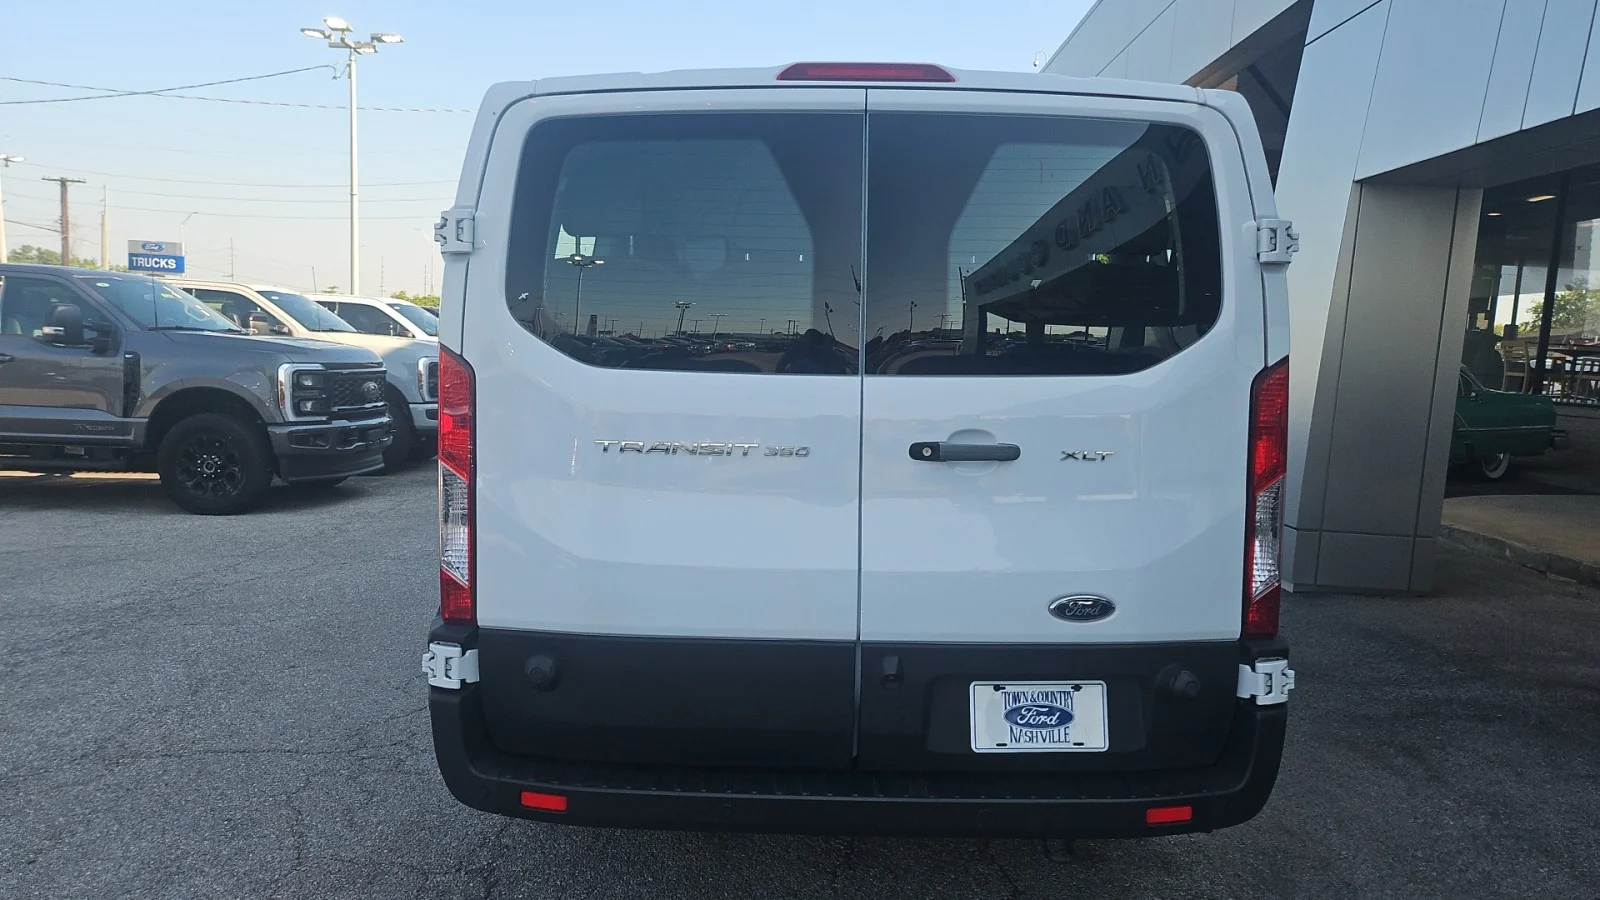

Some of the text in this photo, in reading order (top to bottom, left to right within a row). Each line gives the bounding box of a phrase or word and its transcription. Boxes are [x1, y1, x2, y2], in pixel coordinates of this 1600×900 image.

[131, 257, 177, 269] TRUCKS
[594, 439, 811, 458] TRANSIT 350
[1059, 450, 1115, 462] XLT
[1065, 601, 1102, 616] Ford
[1001, 690, 1029, 712] TOWN
[1036, 690, 1075, 712] COUNTRY
[1017, 706, 1061, 725] Ford
[1009, 725, 1071, 744] NASHVILLE
